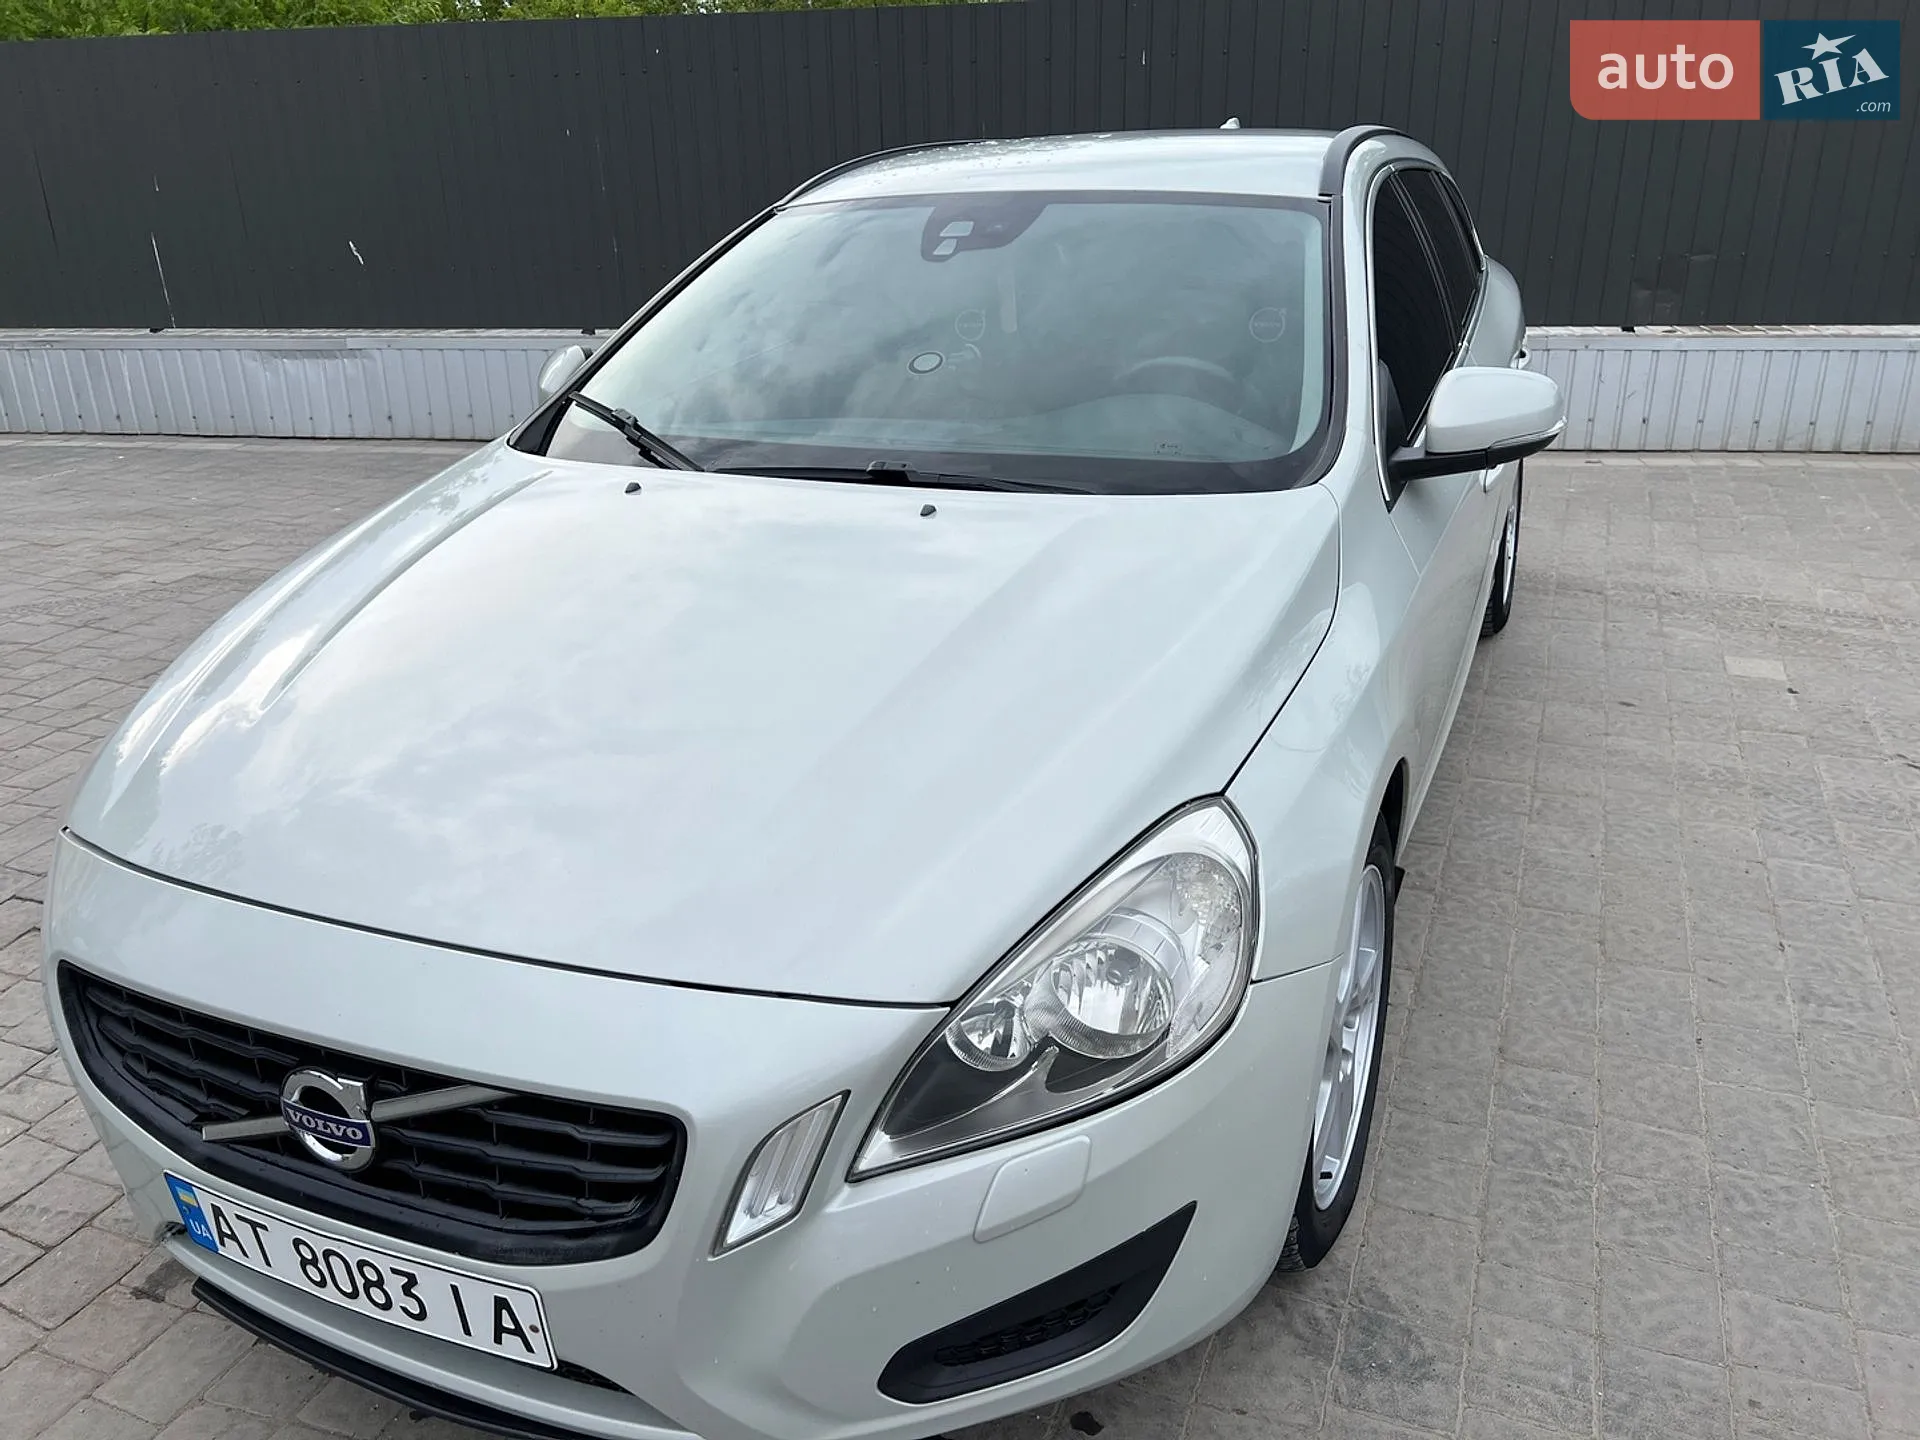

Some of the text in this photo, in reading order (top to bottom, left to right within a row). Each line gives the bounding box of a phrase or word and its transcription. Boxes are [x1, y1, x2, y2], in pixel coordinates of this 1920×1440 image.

[286, 1107, 363, 1140] VOLVO
[189, 1219, 213, 1241] UA
[211, 1203, 535, 1354] AT 8083 IA
